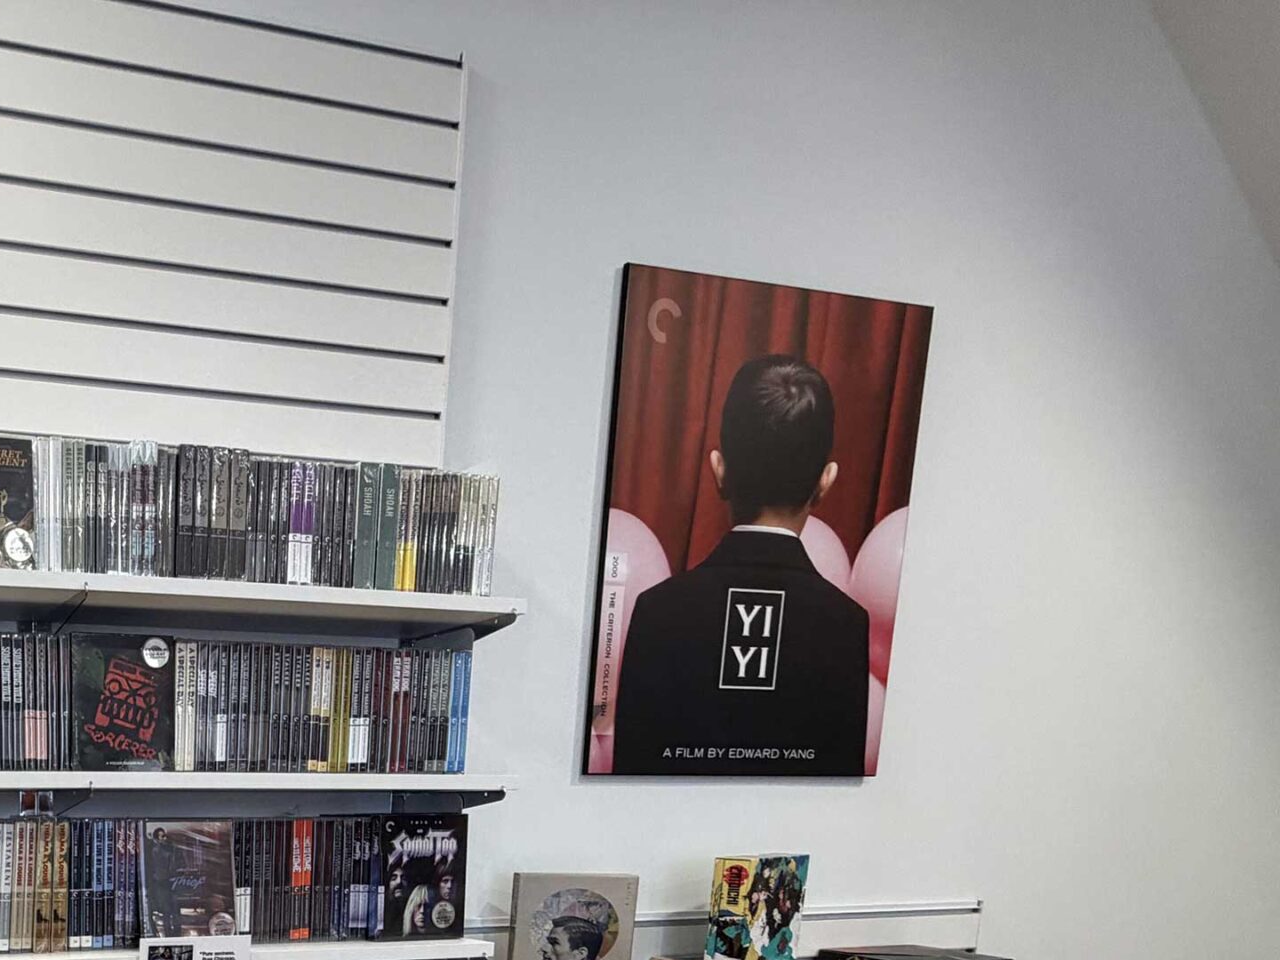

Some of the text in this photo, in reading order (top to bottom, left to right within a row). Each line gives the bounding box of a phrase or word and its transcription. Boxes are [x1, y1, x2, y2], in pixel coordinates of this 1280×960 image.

[363, 487, 373, 516] SHOAH
[385, 489, 395, 517] SHOAH
[734, 604, 773, 638] YI
[731, 646, 769, 679] YI
[84, 724, 157, 760] SORCERER
[663, 747, 815, 760] A FILM BY EDWARD YANG
